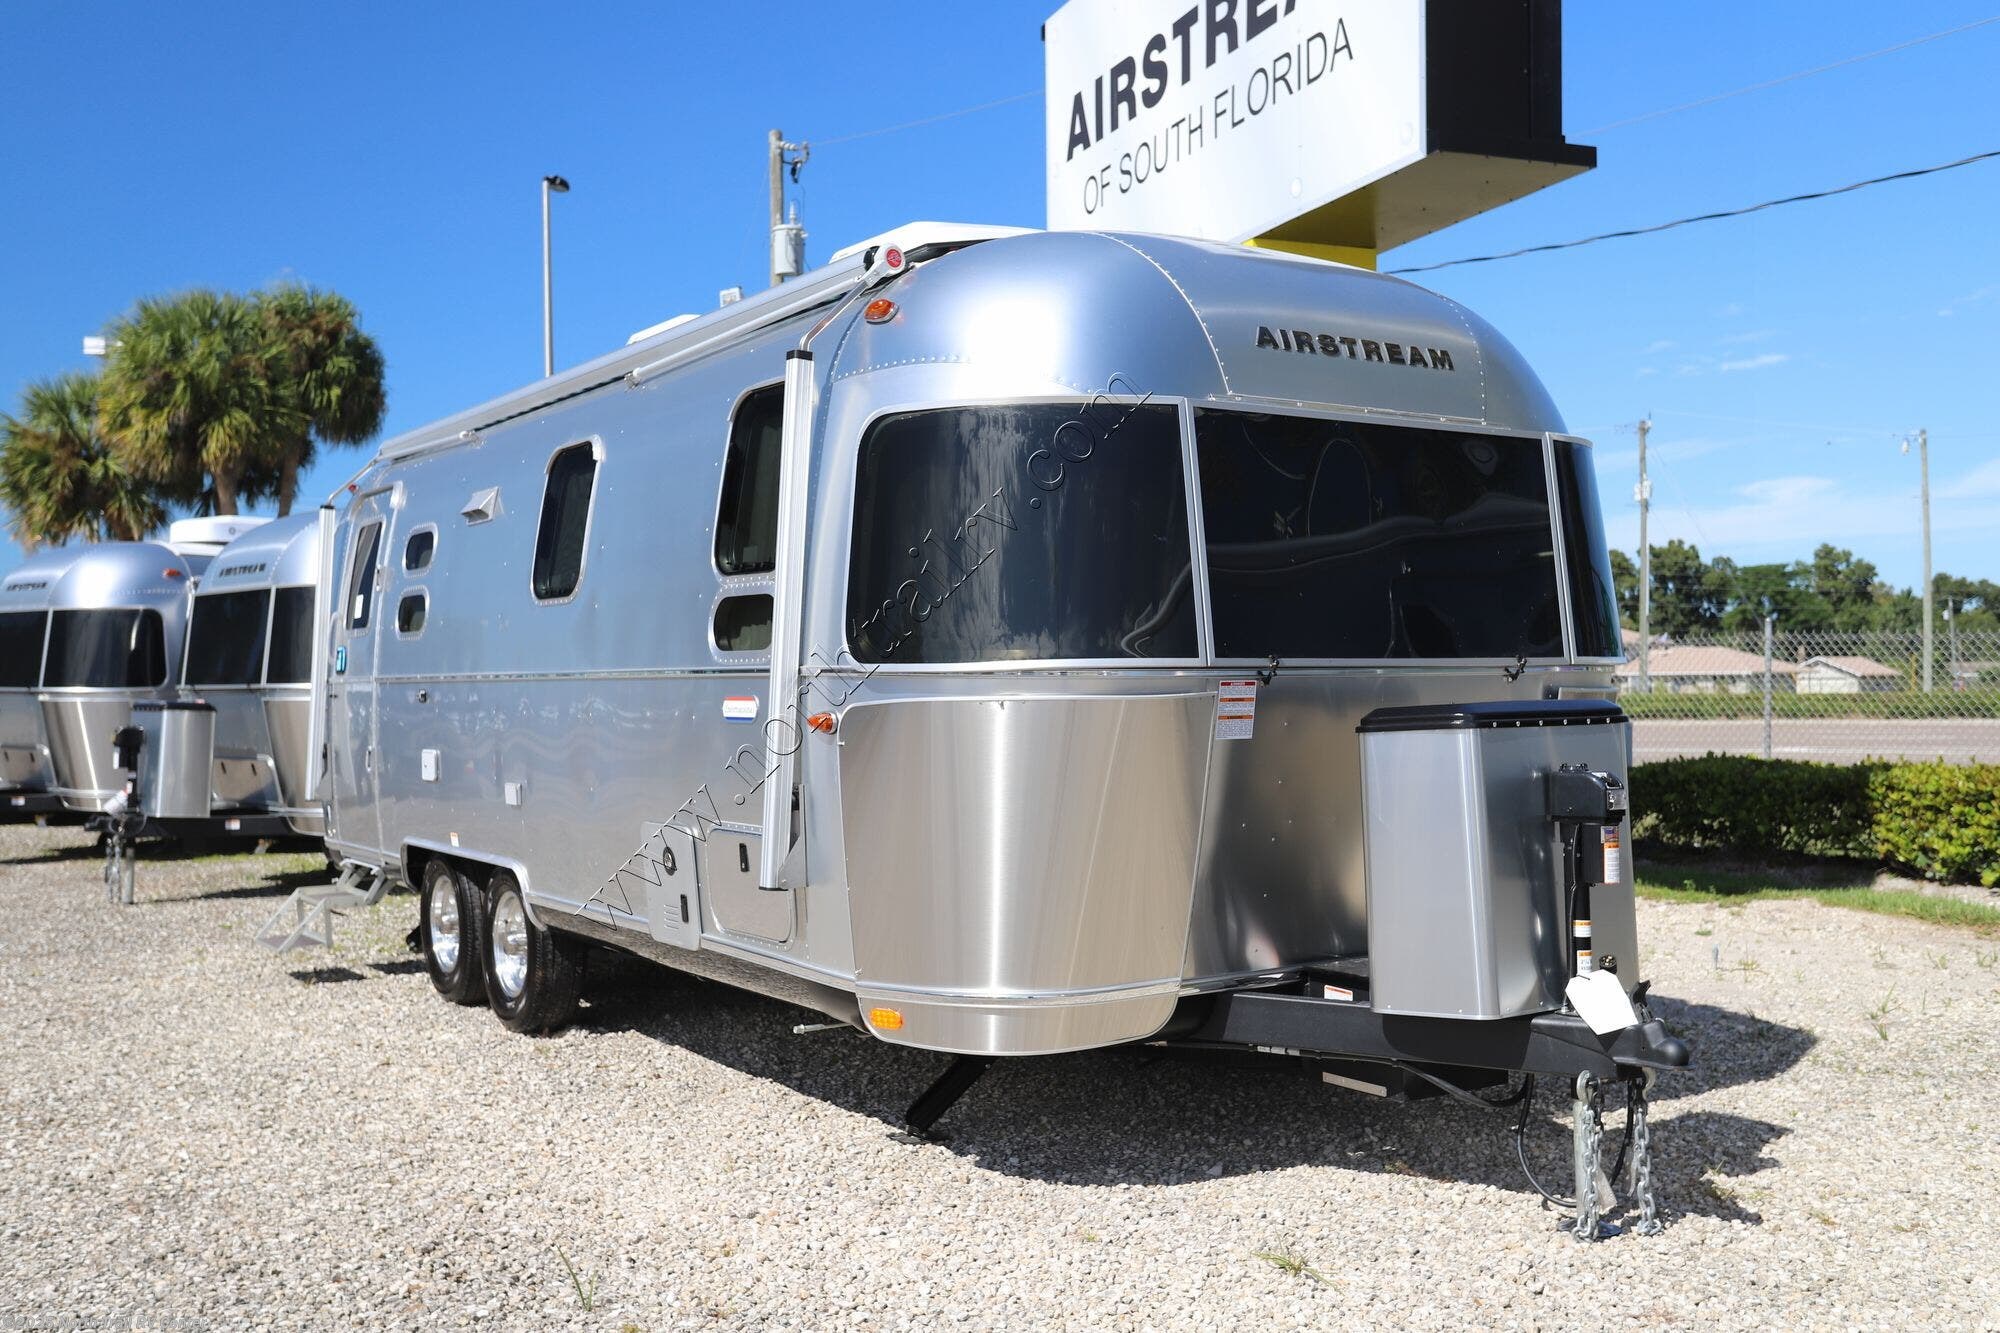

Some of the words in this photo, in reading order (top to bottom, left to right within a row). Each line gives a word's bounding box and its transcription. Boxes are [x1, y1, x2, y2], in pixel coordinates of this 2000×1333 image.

[1066, 0, 1296, 162] AIRSTRE
[1084, 164, 1111, 214] OF
[1119, 105, 1203, 193] SOUTH
[1214, 17, 1353, 139] FLORIDA
[1256, 325, 1455, 371] AIRSTREAM
